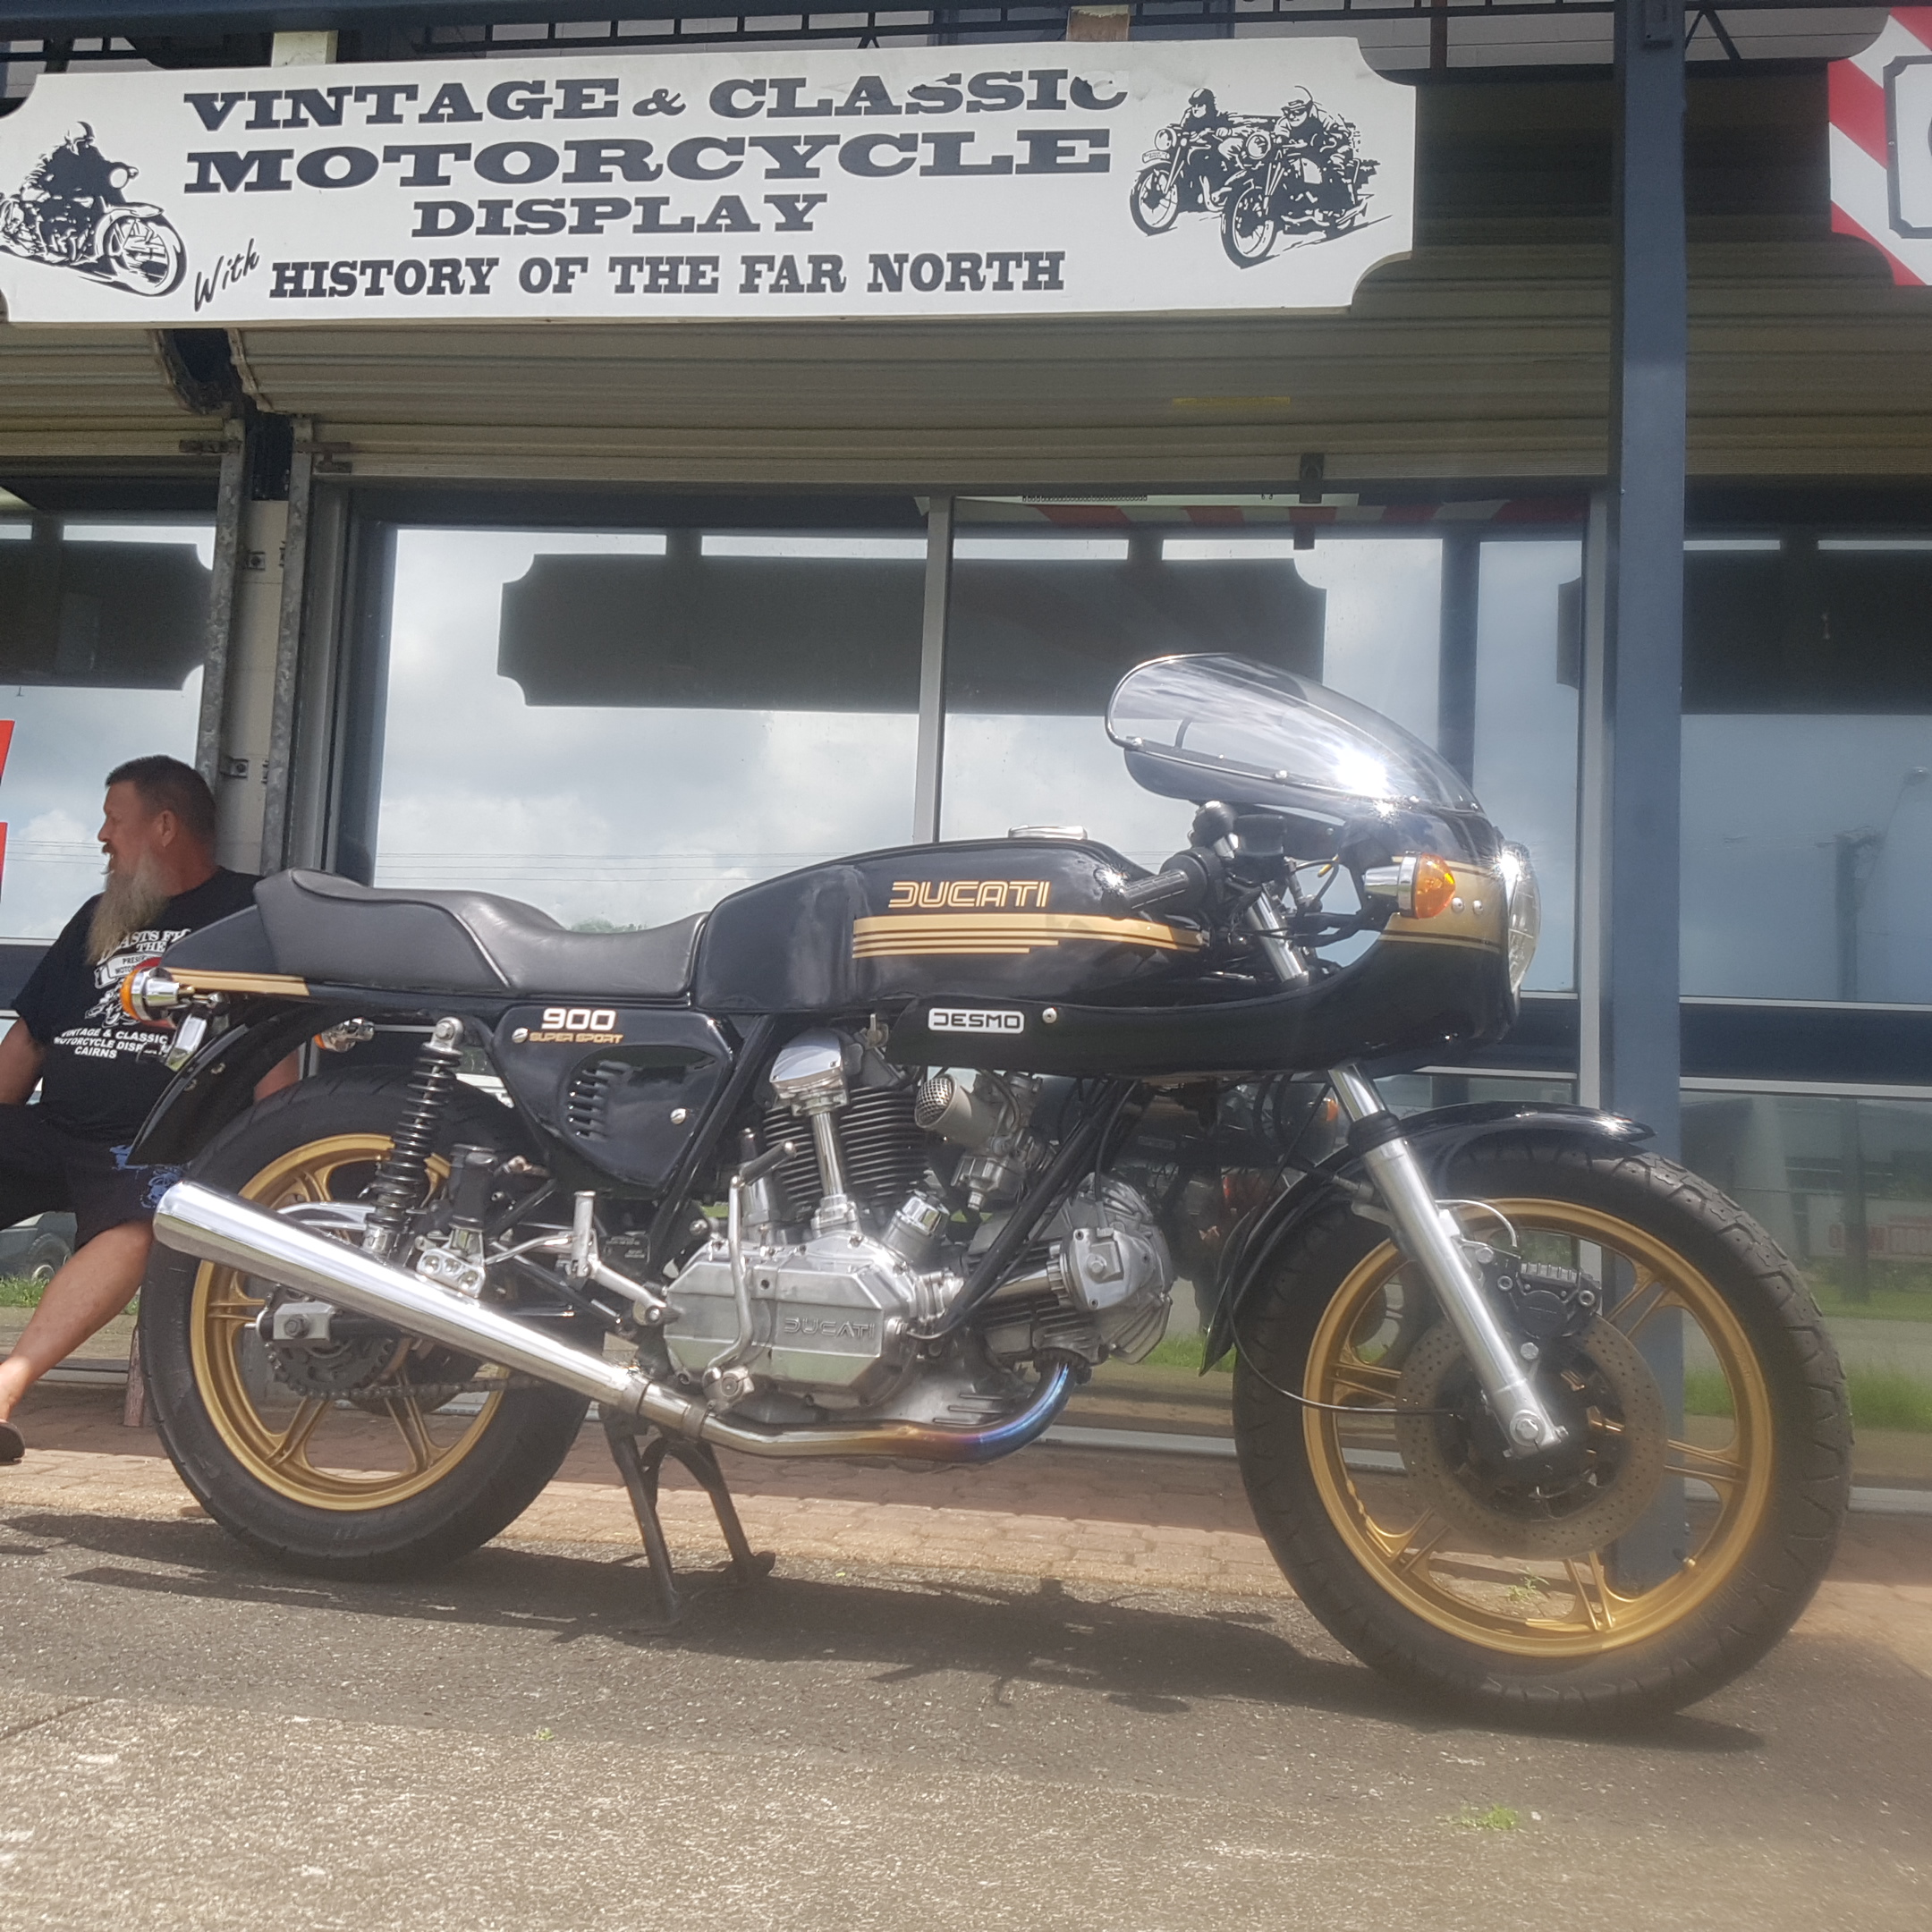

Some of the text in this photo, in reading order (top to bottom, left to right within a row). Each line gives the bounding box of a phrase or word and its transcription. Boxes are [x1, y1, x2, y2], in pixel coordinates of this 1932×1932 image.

[184, 69, 1128, 131] VINTAGE & CLASSIC
[184, 129, 1110, 192] MOTORCYCLE
[412, 194, 827, 237] DISPLAY
[194, 238, 1064, 311] With HISTORY OF THE FAR NORTH
[888, 880, 1051, 908] DUCATI
[136, 941, 167, 953] THE
[541, 1007, 617, 1031] 900
[933, 1011, 1021, 1030] DESMO
[54, 1036, 115, 1049] MOTORCYCLE
[62, 1027, 168, 1045] VINTAGE & CLASSIC
[529, 1032, 623, 1045] SUPER SPORT
[74, 1045, 118, 1060] CAIRNS
[784, 1317, 876, 1339] DUCATI
